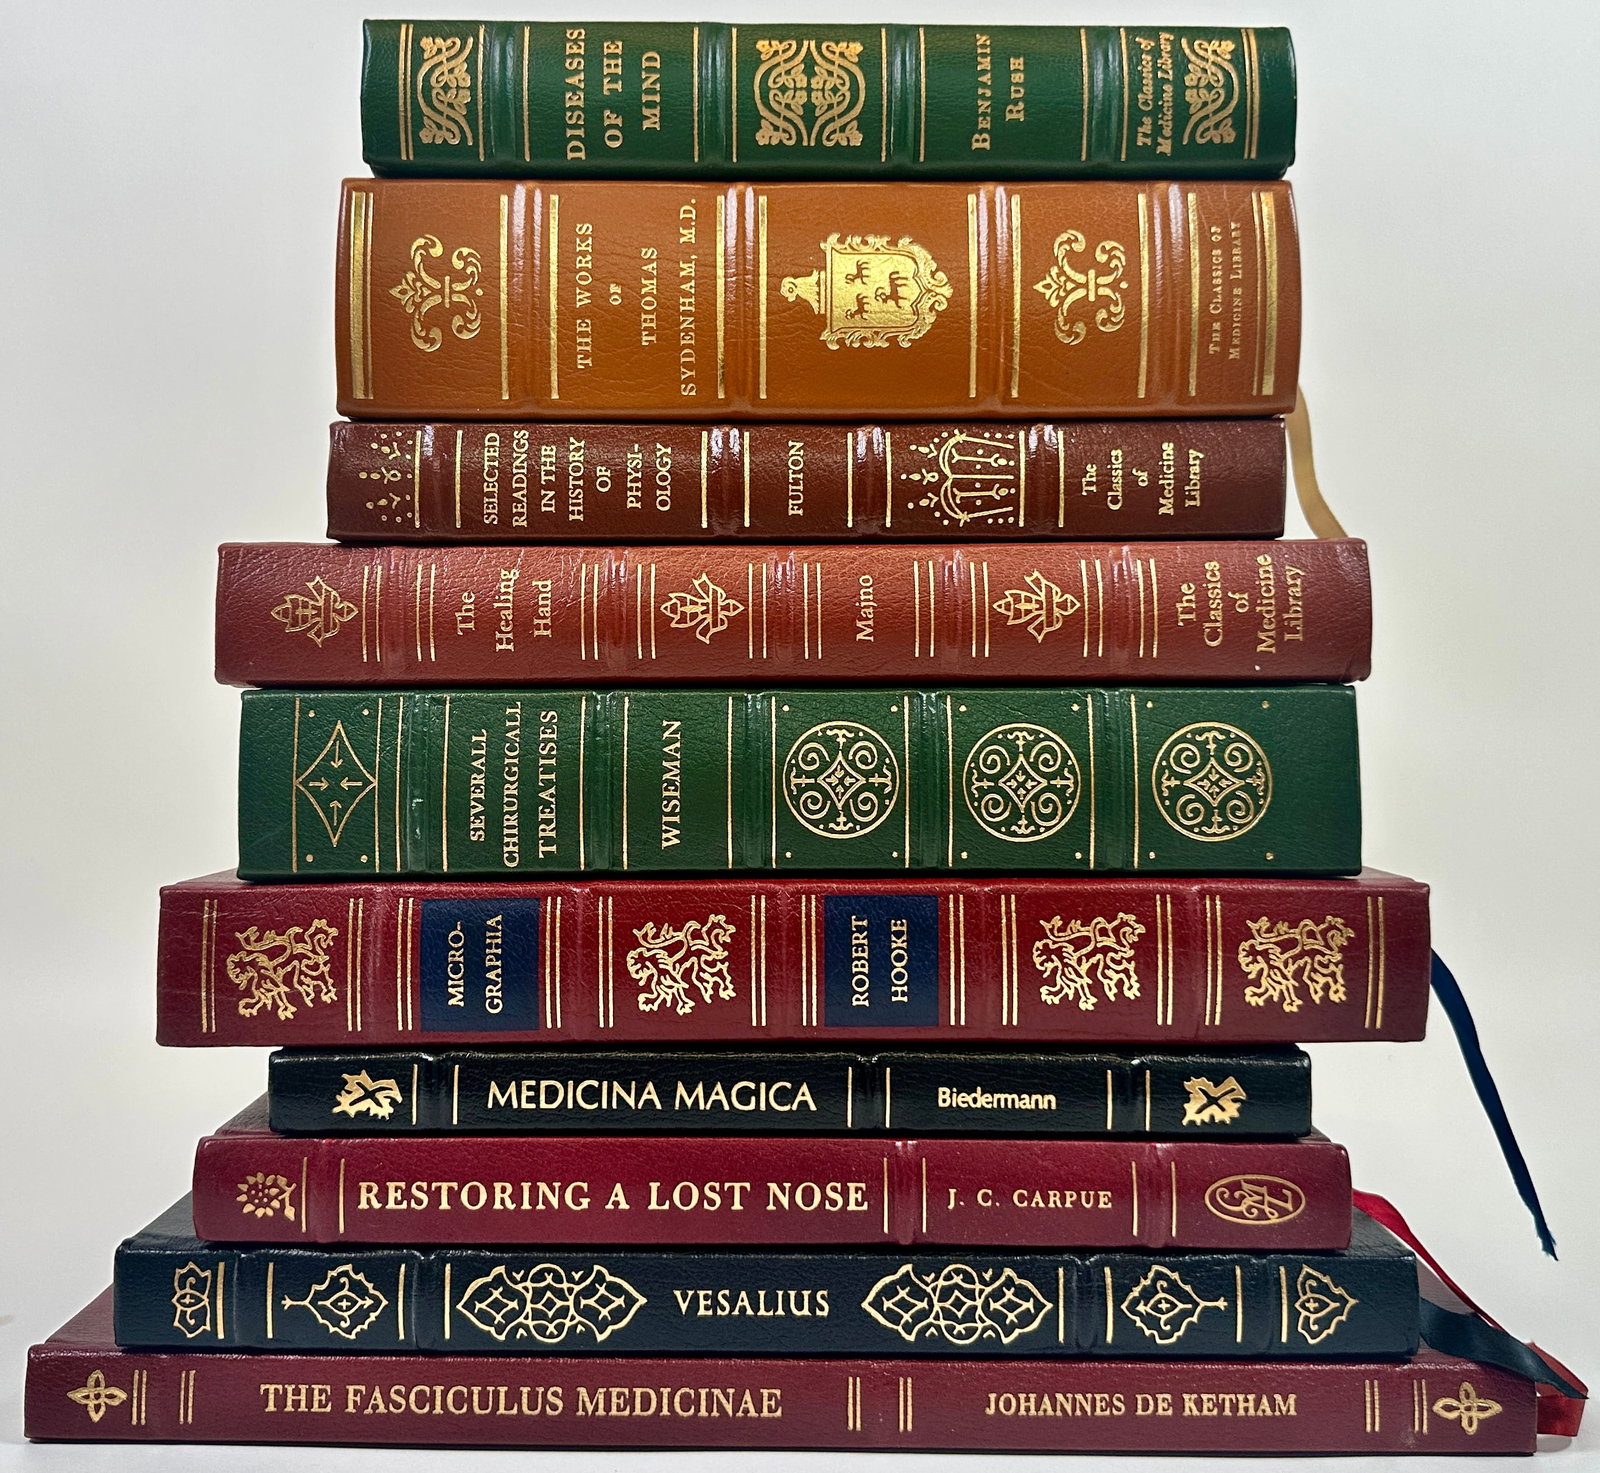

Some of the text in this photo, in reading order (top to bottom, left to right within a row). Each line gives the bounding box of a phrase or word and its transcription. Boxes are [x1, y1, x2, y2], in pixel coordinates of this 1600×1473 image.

[566, 28, 586, 161] DISEASES
[604, 40, 623, 148] OF THE
[641, 50, 661, 131] MIND
[972, 33, 991, 151] BENJAMIN
[1005, 57, 1025, 121] RUSH
[1136, 36, 1156, 146] The Classics of
[1156, 32, 1174, 156] Medicine Library
[576, 222, 593, 369] THE WORKS
[609, 284, 622, 305] OF
[641, 246, 657, 346] THOMAS
[680, 198, 699, 396] SYDENHAM, M.D.
[483, 432, 500, 525] SELECTED
[512, 429, 529, 528] READINGS
[541, 445, 557, 513] IN THE
[568, 437, 586, 522] HISTORY
[597, 465, 612, 493] OF
[626, 443, 643, 508] PHYSI-
[656, 443, 673, 512] OLOGY
[788, 440, 805, 516] FULTON
[1081, 464, 1098, 496] The
[1106, 449, 1124, 511] Classics
[1131, 467, 1149, 488] of
[1157, 442, 1175, 516] Medicine
[1183, 449, 1205, 508] Library
[456, 591, 477, 635] The
[494, 569, 521, 652] Healing
[532, 578, 553, 638] Hand
[855, 573, 877, 642] Majno
[1176, 582, 1196, 627] The
[1203, 560, 1223, 648] Classics
[1227, 592, 1250, 614] of
[1255, 554, 1277, 655] Medicine
[1283, 565, 1307, 642] Library
[468, 729, 488, 843] SEVERALL
[502, 700, 522, 869] CHIRURGICALL
[537, 710, 559, 859] TREATISES
[661, 720, 682, 850] WISEMAN
[447, 921, 464, 1008] MICRO-
[484, 914, 504, 1015] GRAPHIA
[851, 915, 870, 1007] ROBERT
[891, 919, 909, 1004] HOOKE
[486, 1079, 819, 1113] MEDICINA MAGICA
[937, 1085, 1058, 1112] Biedermann
[356, 1181, 869, 1213] RESTORING A LOST NOSE
[947, 1189, 1114, 1211] J. C. CARPUE
[672, 1289, 831, 1318] VESALIUS
[259, 1384, 783, 1419] THE FASCICULUS MEDICINAE
[984, 1393, 1299, 1419] JOHANNES DE KETHAM
